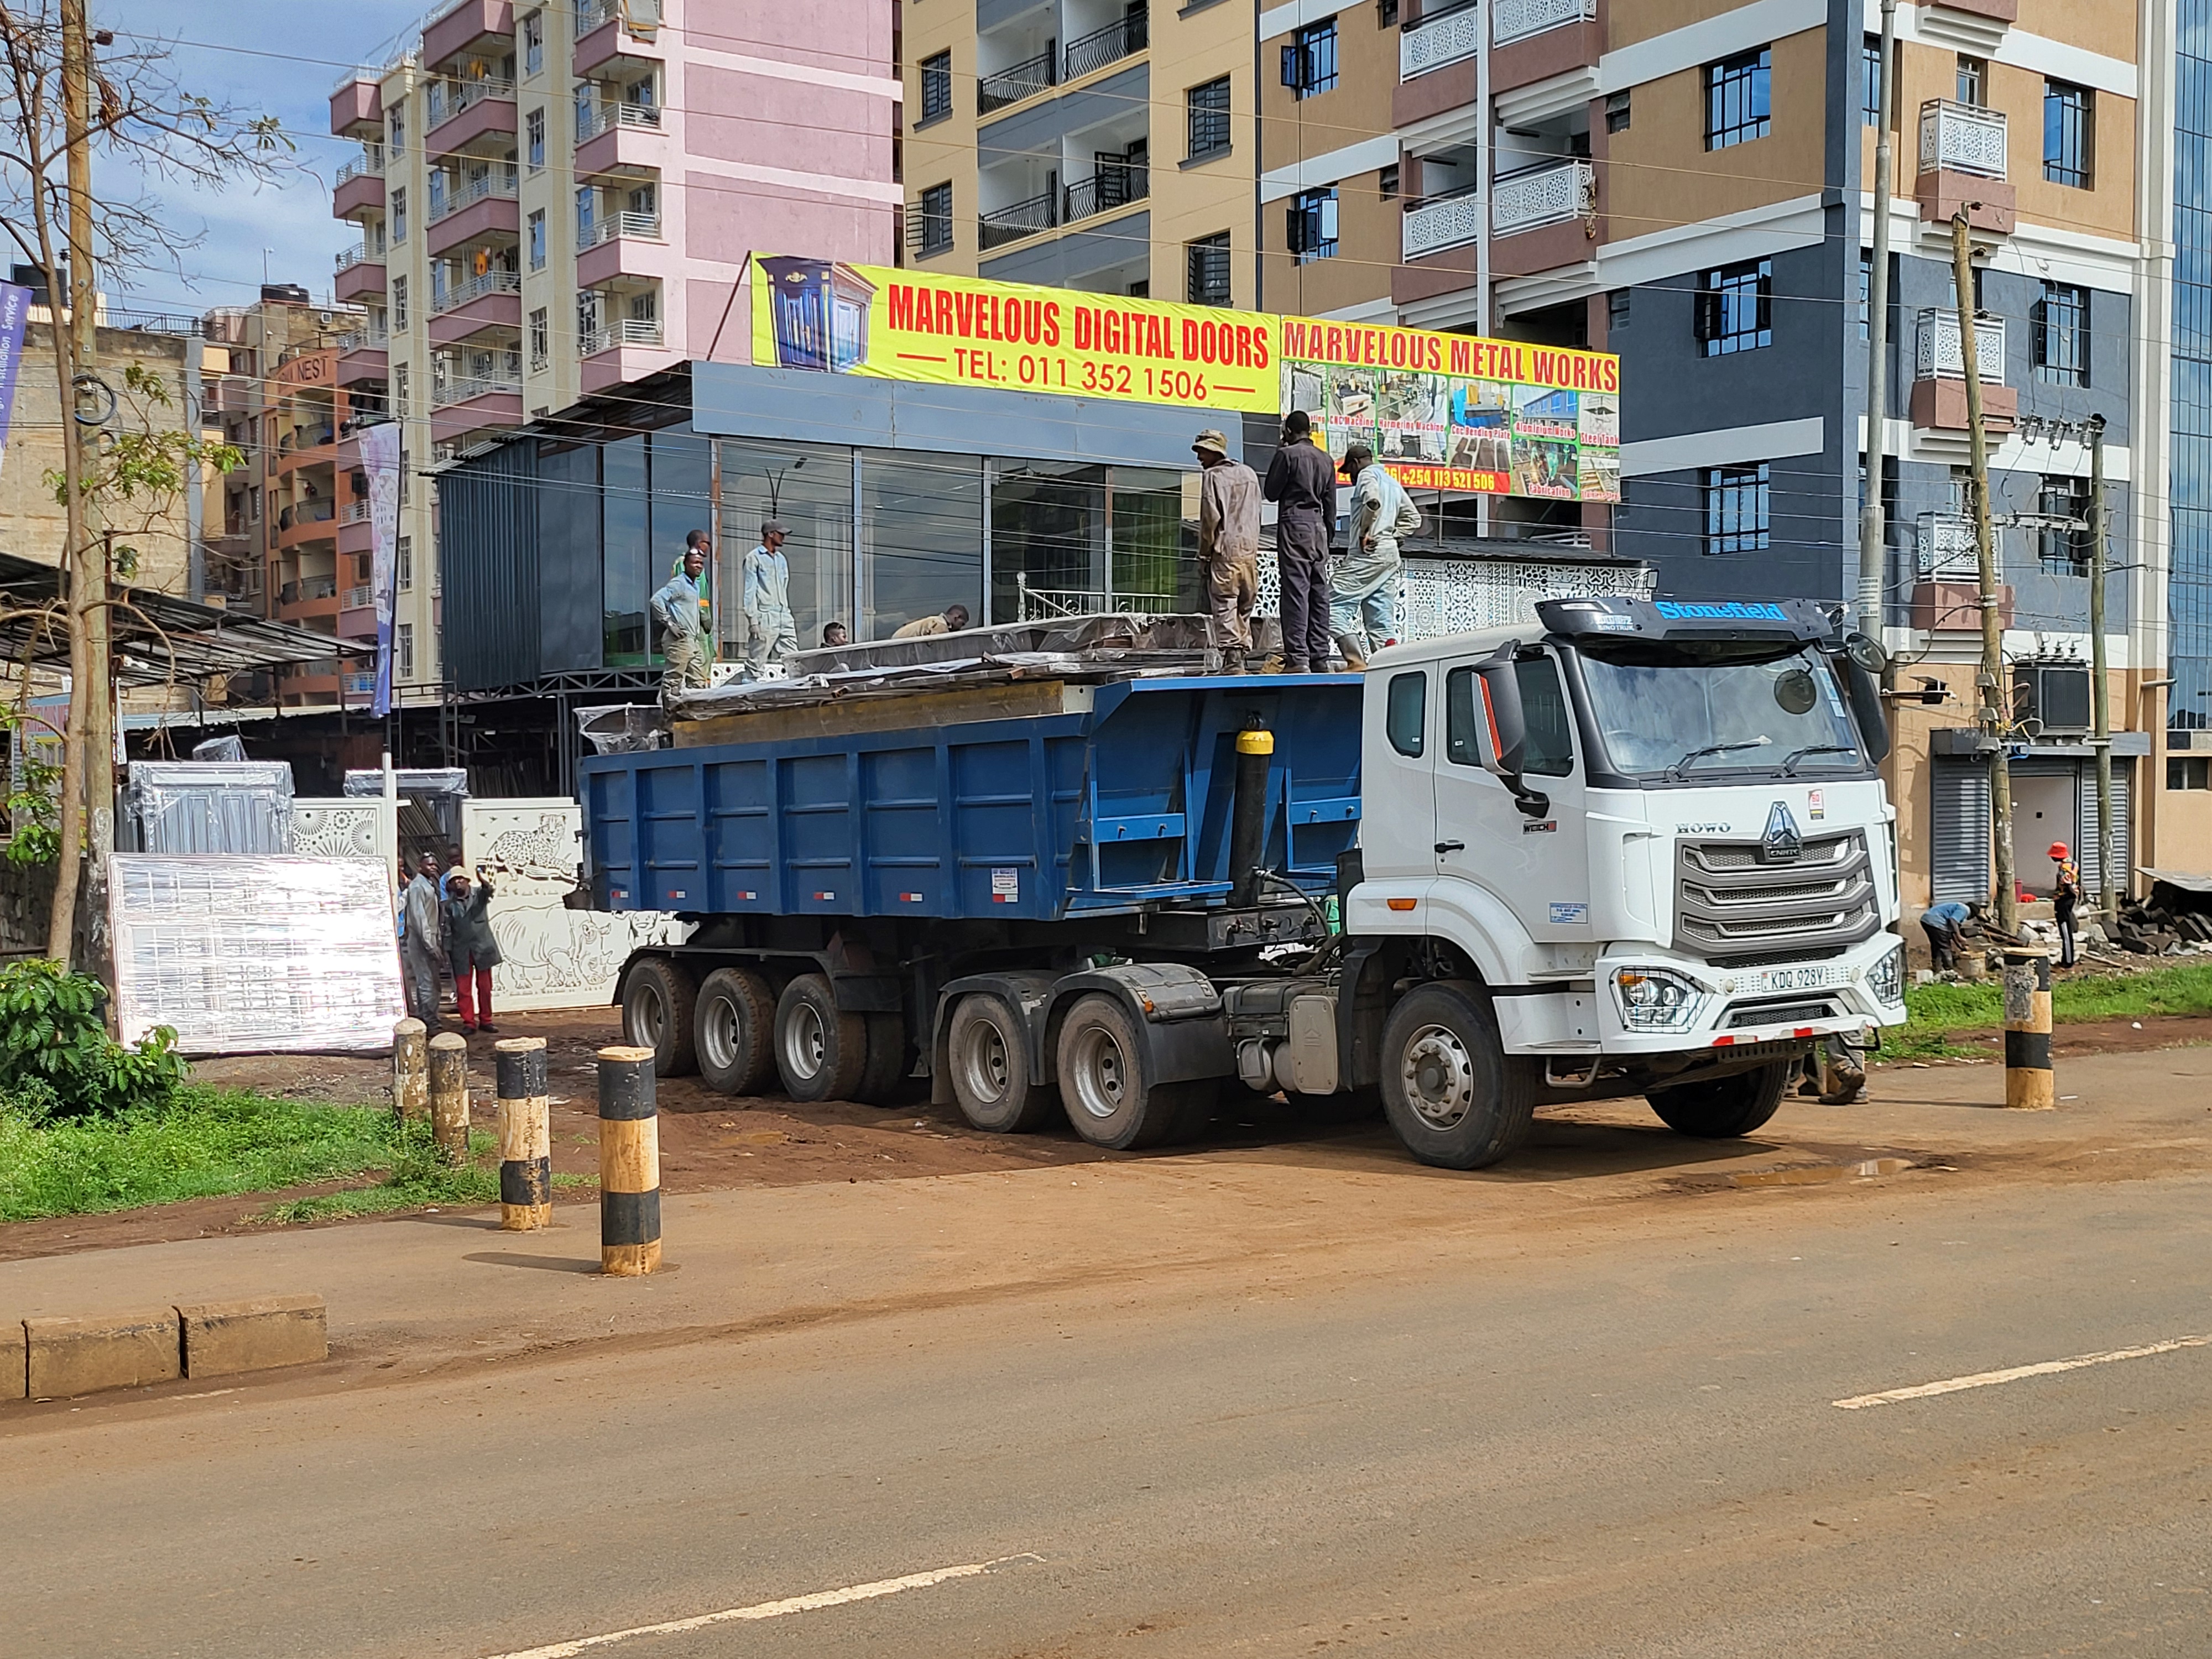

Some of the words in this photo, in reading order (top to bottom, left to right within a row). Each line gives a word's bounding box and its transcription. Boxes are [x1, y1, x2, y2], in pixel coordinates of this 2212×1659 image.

[889, 284, 1060, 347] MARVELOUS
[1074, 305, 1175, 359] DIGITAL
[1182, 318, 1268, 369] DOORS
[1284, 322, 1441, 371] MARVELOUS
[1451, 339, 1525, 380] METAL
[1533, 350, 1616, 392] WORKS
[298, 356, 328, 382] NEST
[954, 348, 1006, 382] TEL:
[1018, 354, 1067, 387] 011
[1081, 361, 1132, 394] 352
[1144, 368, 1207, 401] 1506
[1329, 415, 1343, 425] CNC
[1344, 416, 1374, 426] Machine
[1416, 421, 1444, 431] Machine
[1516, 421, 1553, 435] Aluminium
[1554, 426, 1575, 438] Works
[1465, 426, 1493, 440] Bending
[1494, 429, 1511, 440] Plate
[1581, 432, 1600, 444] Steel
[1601, 434, 1619, 445] Tank
[1402, 468, 1431, 487] +254
[1434, 469, 1451, 487] 113
[1453, 472, 1471, 489] 521
[1473, 473, 1495, 491] 506
[1655, 601, 1788, 621] Stonefield
[1675, 822, 1731, 834] HOWO
[1771, 971, 1792, 990] KDQ
[1797, 968, 1823, 987] 928Y
